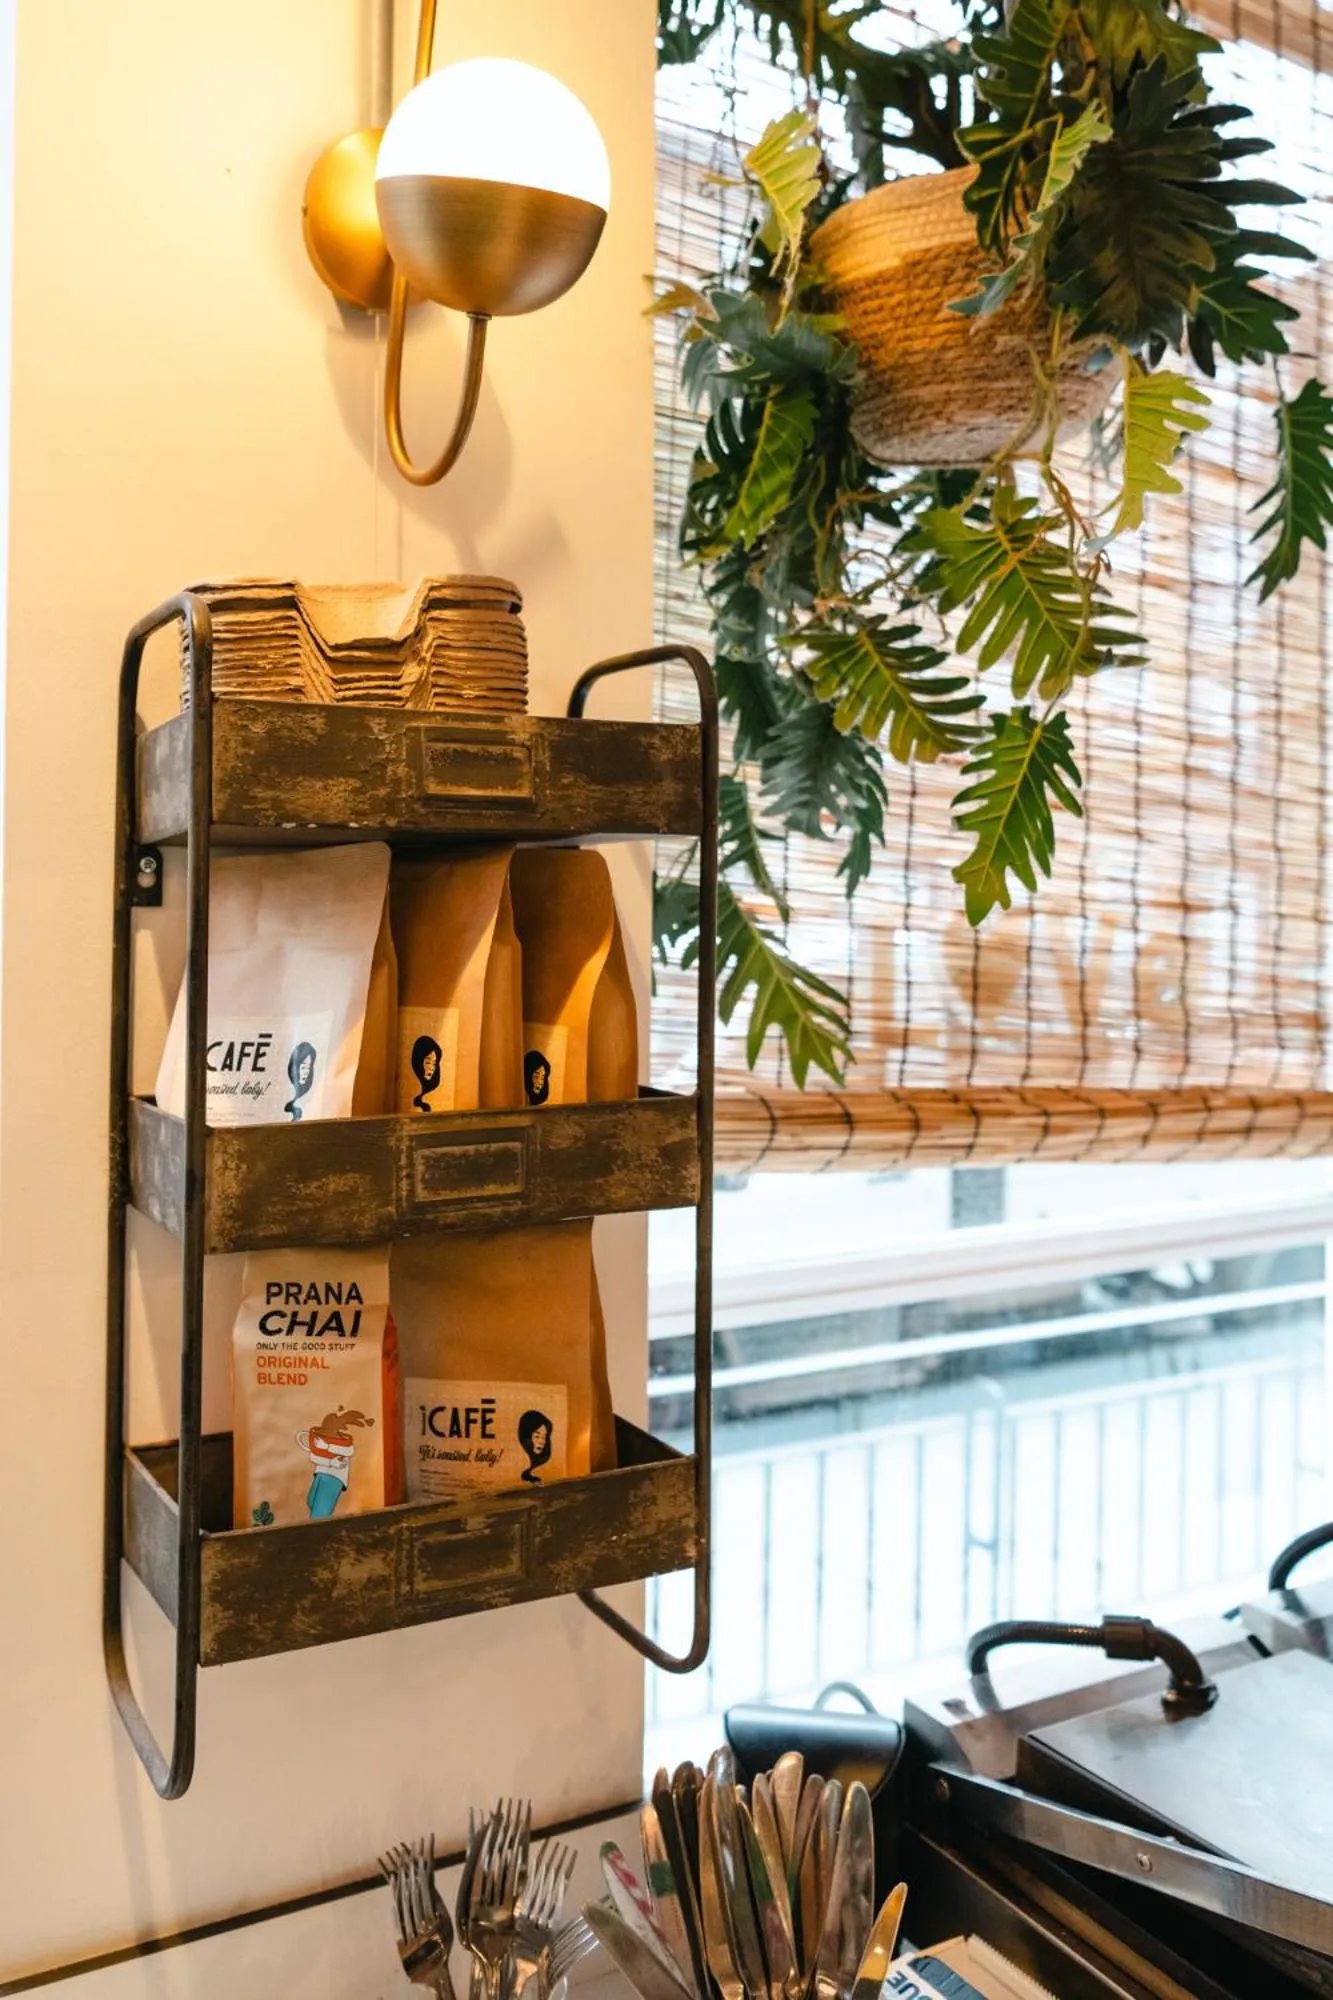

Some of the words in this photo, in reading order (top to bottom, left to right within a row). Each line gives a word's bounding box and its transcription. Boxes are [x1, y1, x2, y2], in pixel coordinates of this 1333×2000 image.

[265, 1281, 364, 1305] PRANA
[258, 1310, 362, 1338] CHAI
[256, 1342, 279, 1351] ONLY
[281, 1342, 298, 1350] THE
[301, 1342, 327, 1351] GOOD
[328, 1343, 357, 1352] STUFF
[256, 1355, 330, 1370] ORIGINAL
[256, 1372, 308, 1386] BLEND
[886, 1970, 934, 2000] UE
